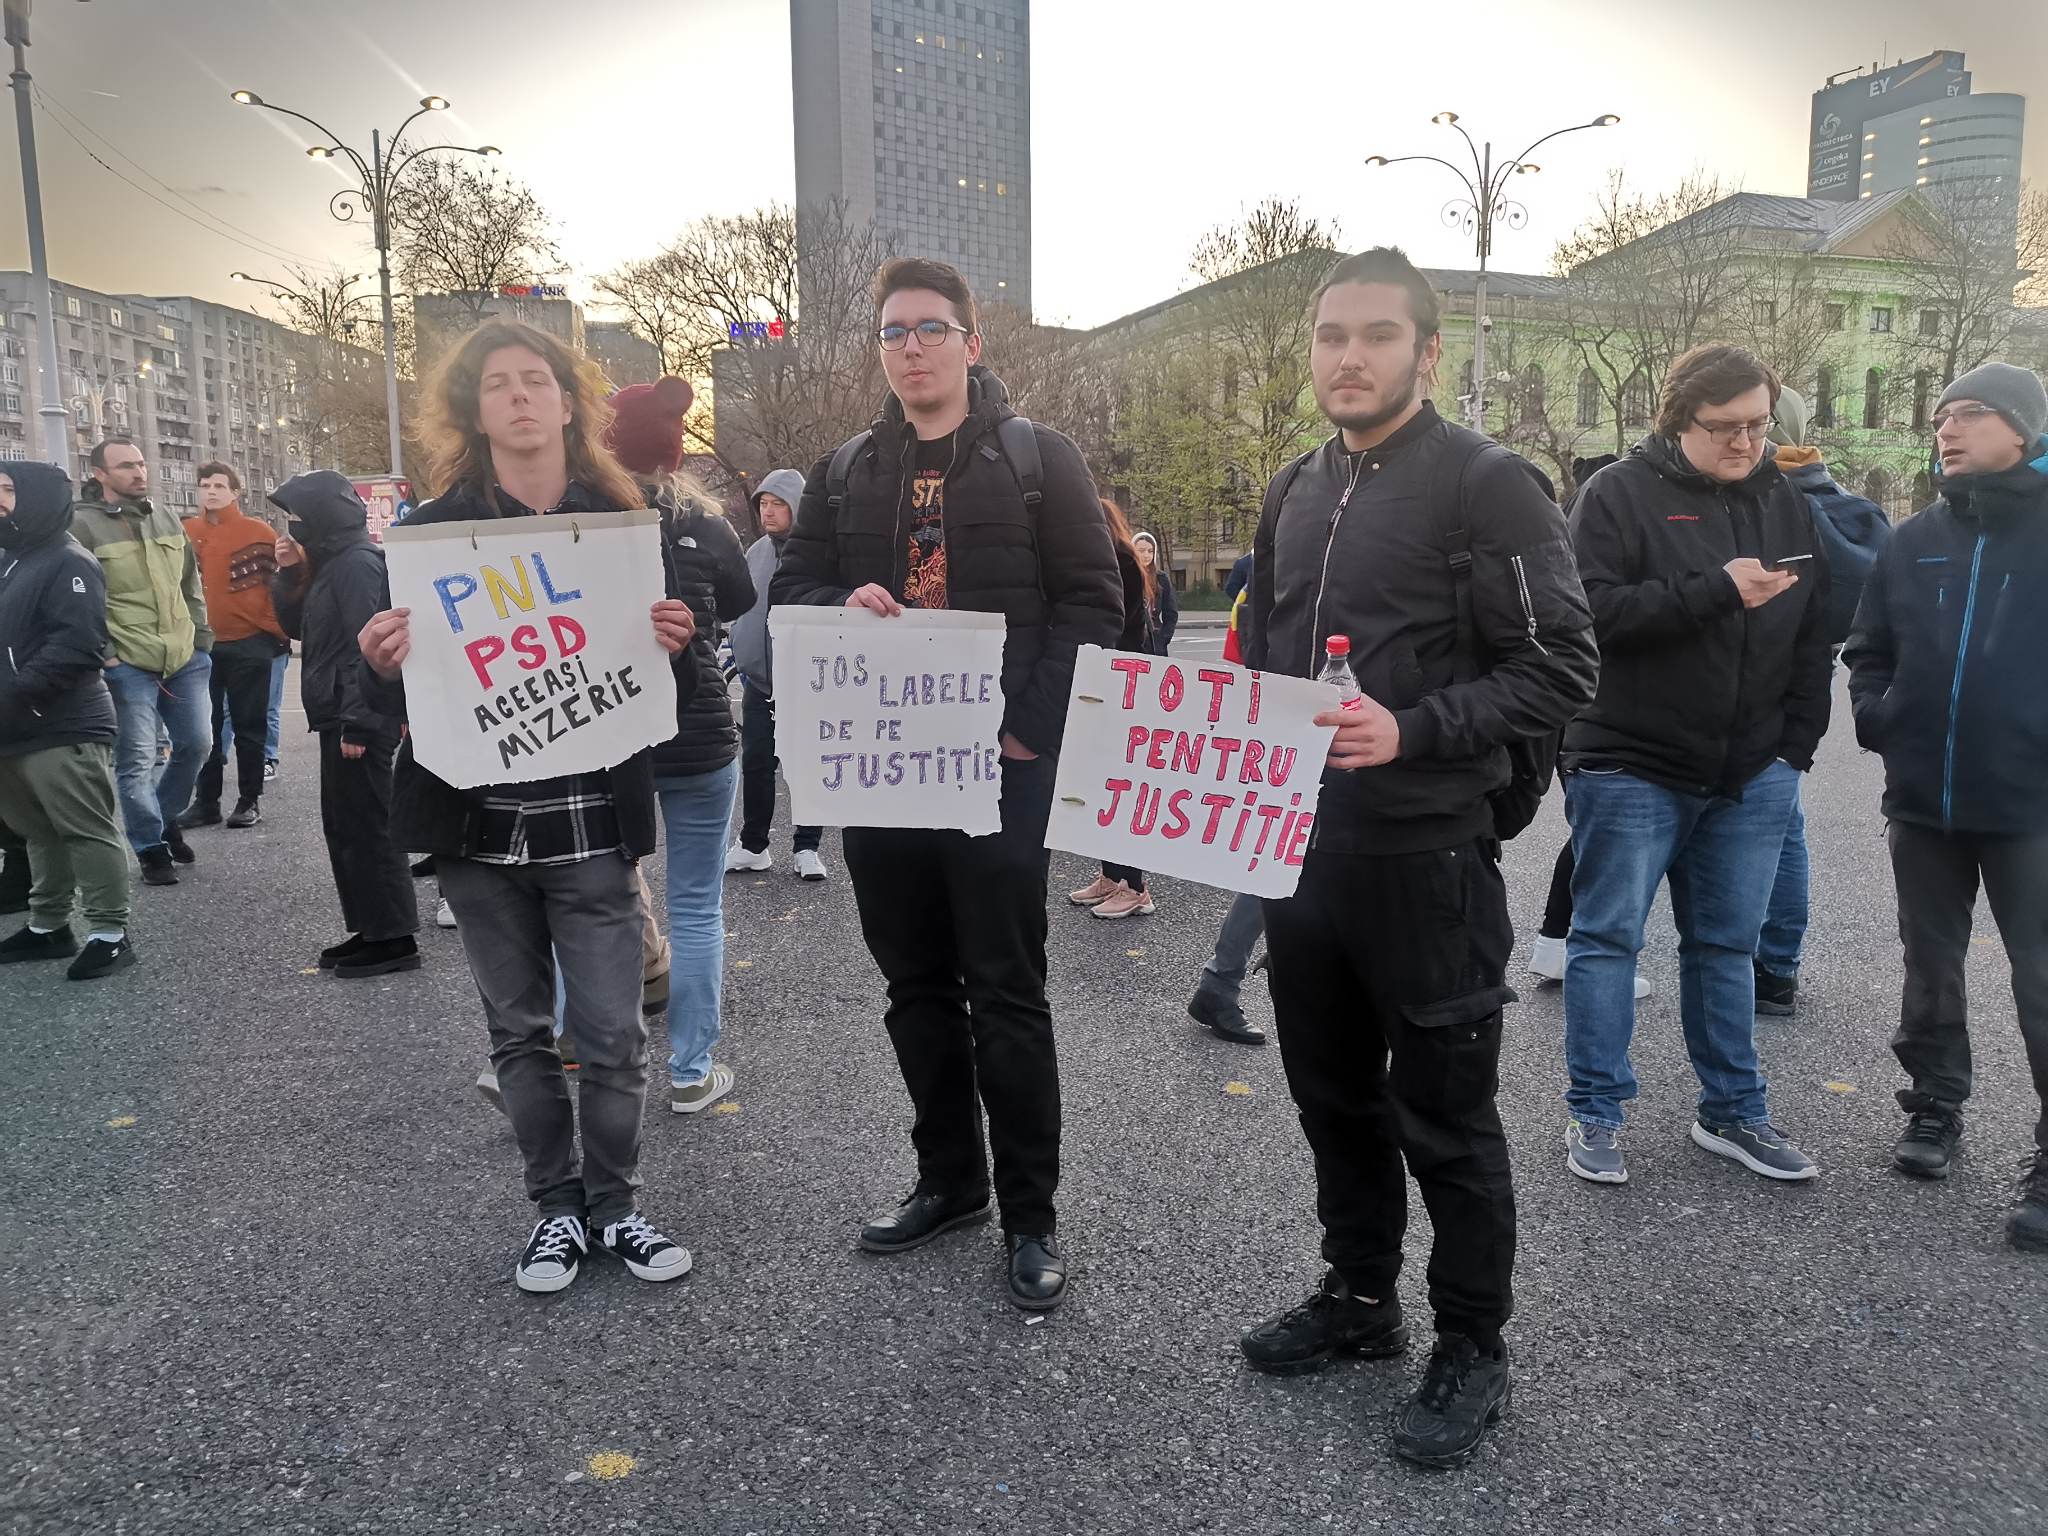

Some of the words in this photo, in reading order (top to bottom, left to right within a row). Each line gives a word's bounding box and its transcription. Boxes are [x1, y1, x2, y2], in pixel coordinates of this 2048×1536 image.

[1869, 76, 1890, 97] EY
[1946, 84, 1960, 97] EY
[433, 552, 583, 634] PNL
[464, 615, 587, 691] PSD
[810, 654, 869, 693] JOS
[879, 673, 994, 707] LABELE
[819, 720, 853, 741] DE
[876, 720, 902, 741] PE
[1126, 726, 1298, 787] PENTRU
